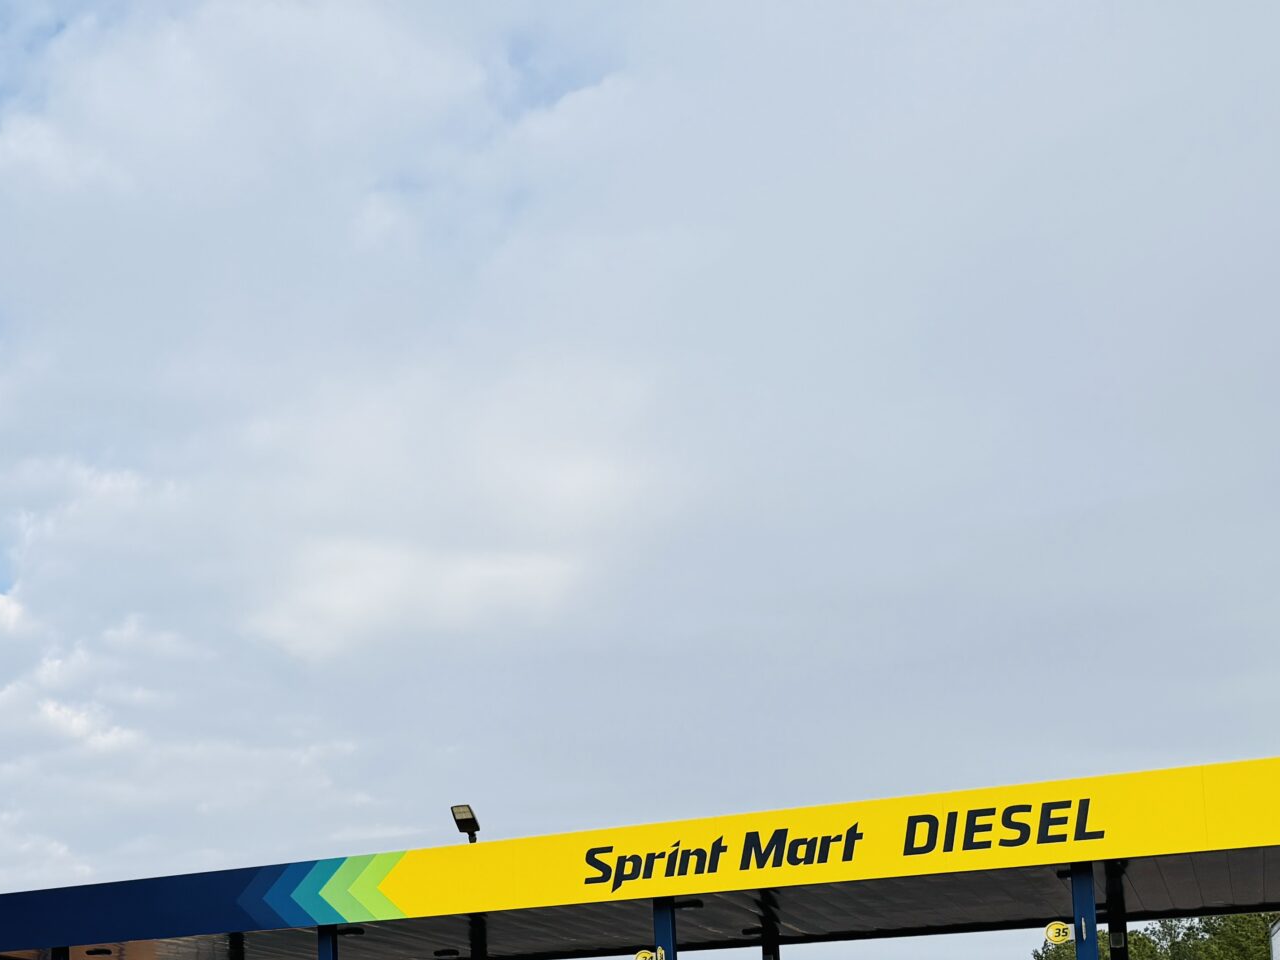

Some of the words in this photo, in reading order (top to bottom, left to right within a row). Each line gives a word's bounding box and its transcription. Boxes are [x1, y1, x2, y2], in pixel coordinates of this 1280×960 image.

[584, 835, 728, 894] Sprint
[738, 821, 864, 872] Mart
[902, 797, 1106, 857] DIESEL
[1054, 927, 1069, 938] 35
